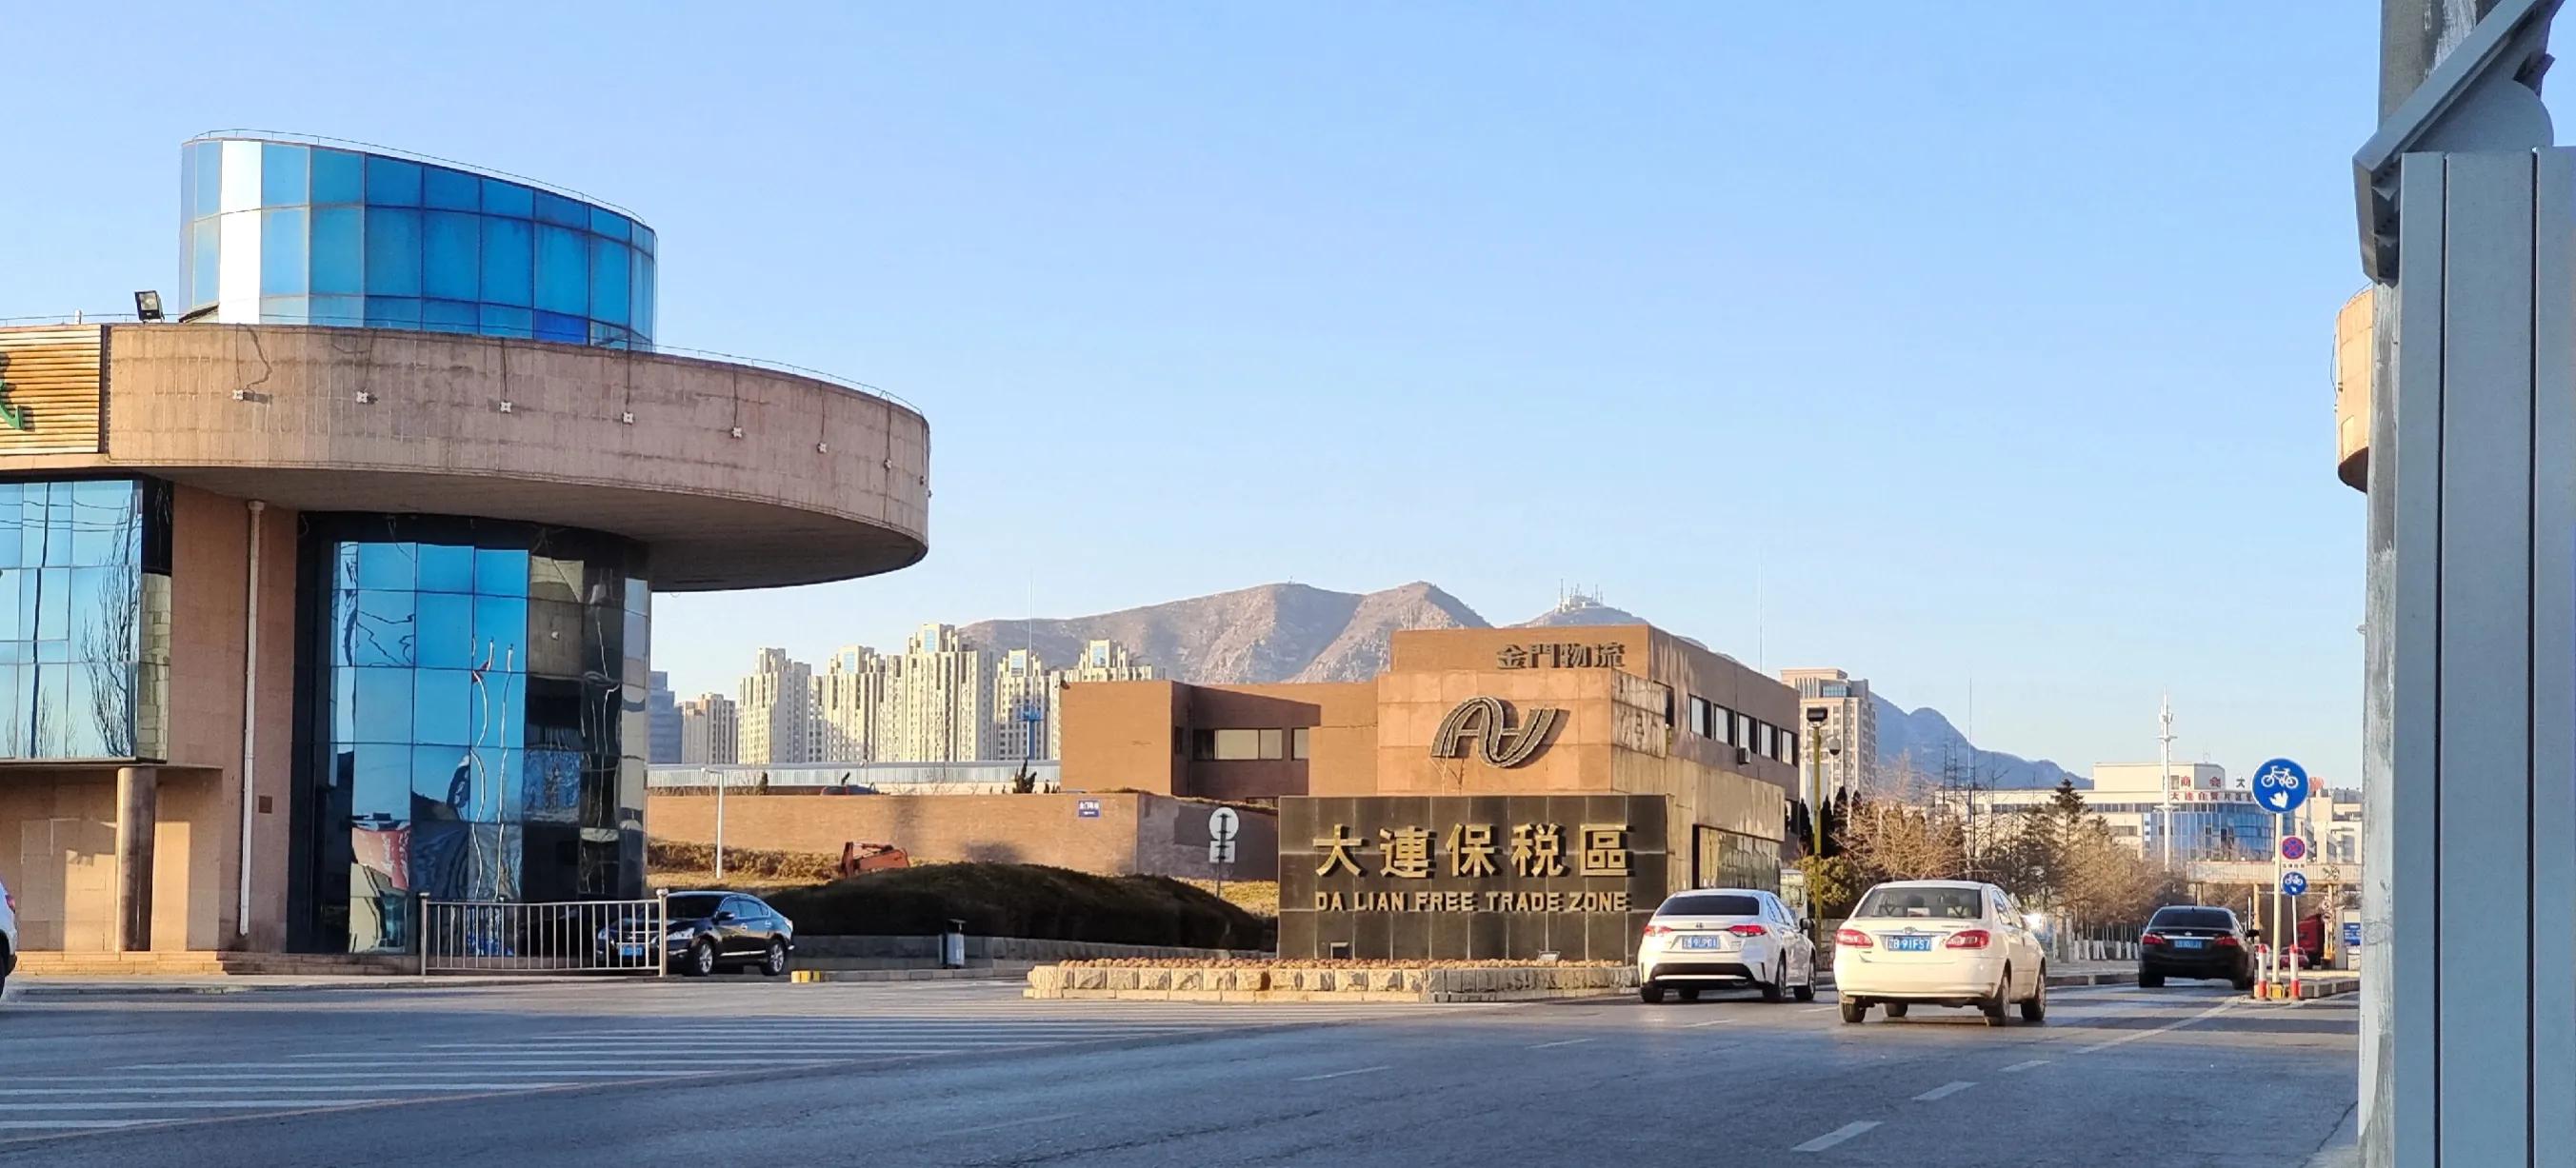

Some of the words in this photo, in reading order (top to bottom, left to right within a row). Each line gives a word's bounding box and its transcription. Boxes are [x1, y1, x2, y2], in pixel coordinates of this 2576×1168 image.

[1496, 643, 1626, 669] 金門物流
[1312, 822, 1629, 879] 大連保税區
[1314, 891, 1344, 912] DA
[1353, 891, 1406, 912] LIAN
[1414, 891, 1475, 912] FREE
[1485, 891, 1561, 912] TRADE
[1568, 891, 1629, 912] ZONE
